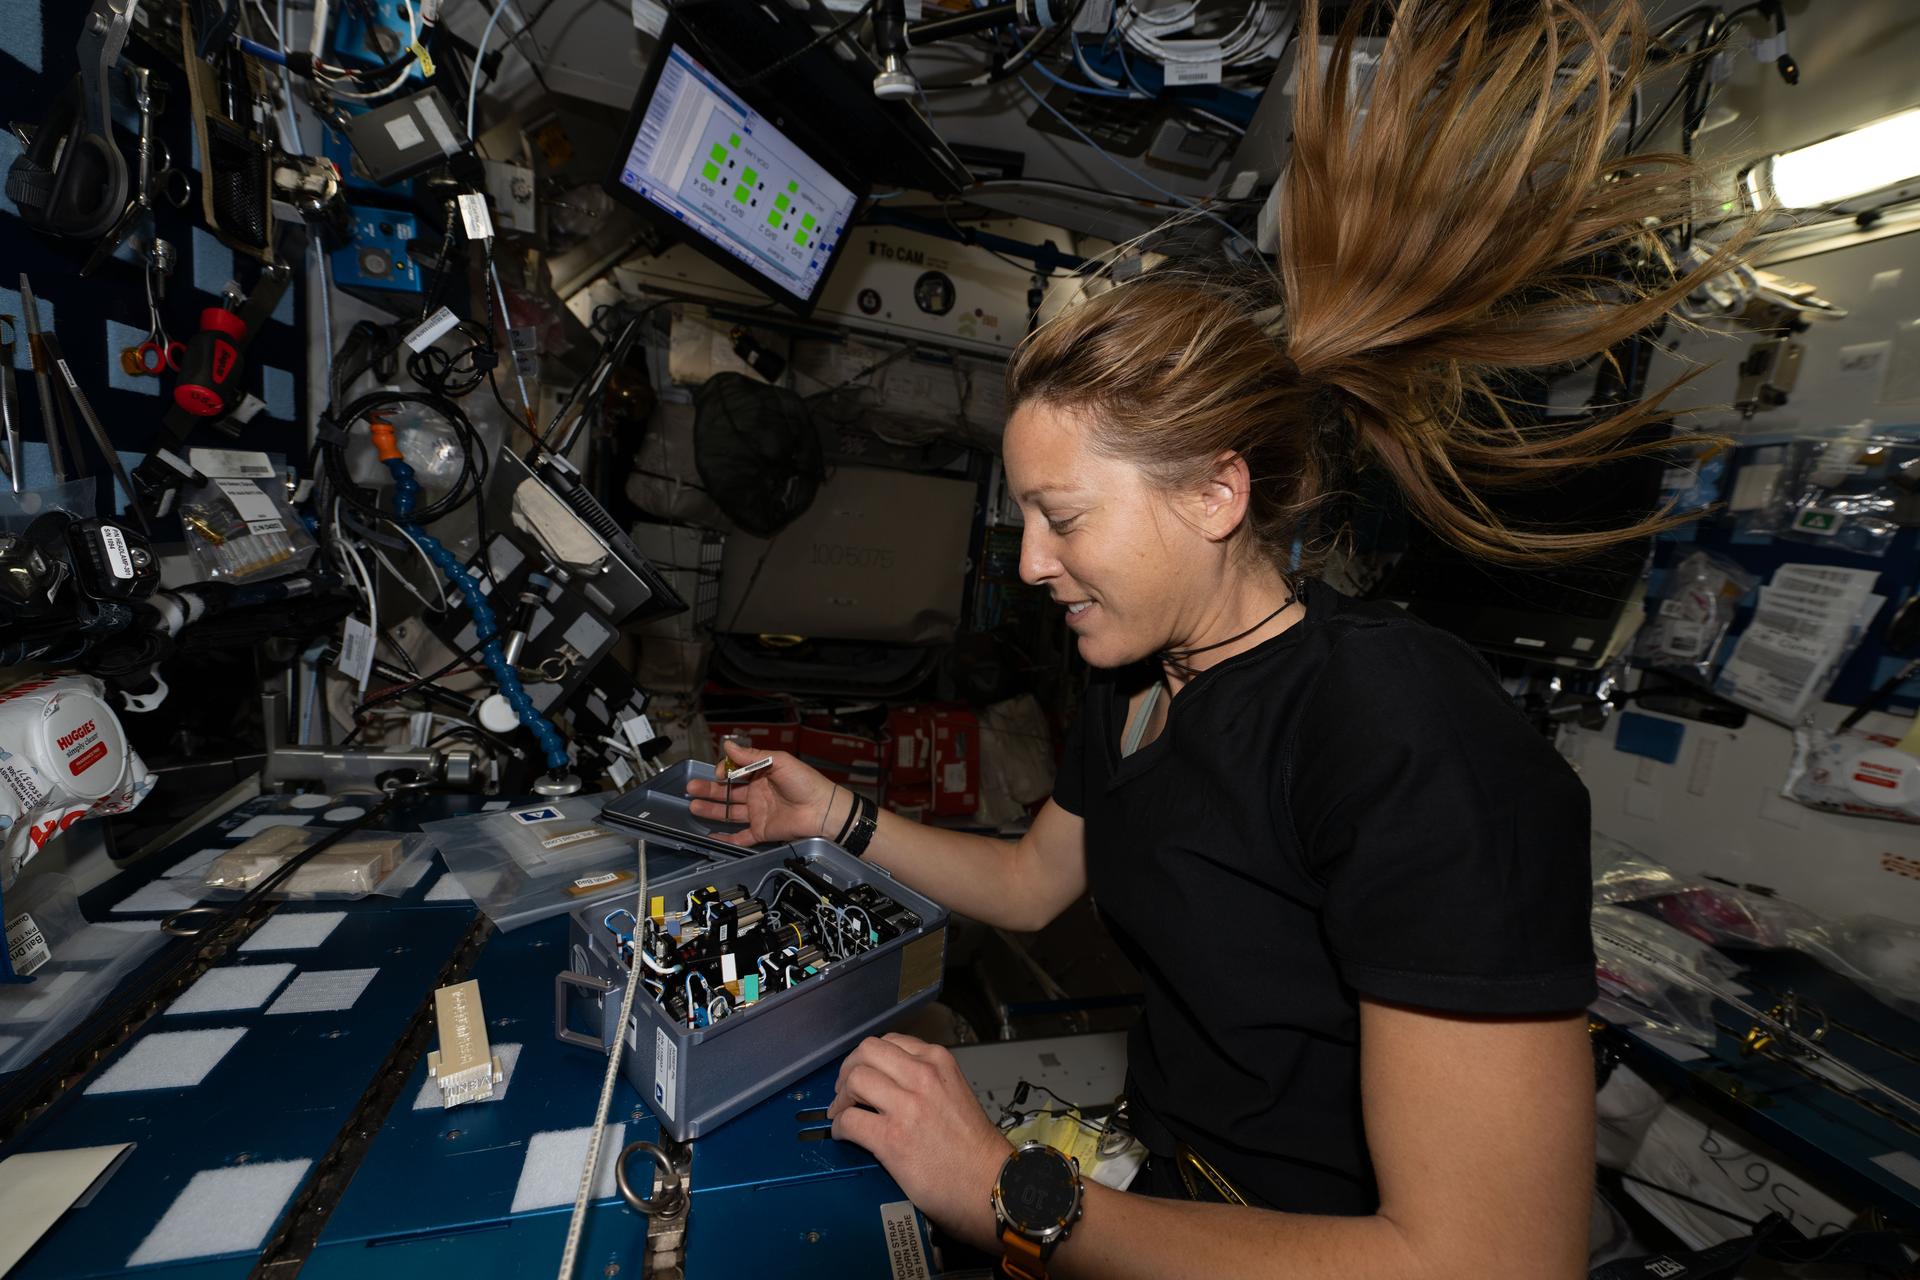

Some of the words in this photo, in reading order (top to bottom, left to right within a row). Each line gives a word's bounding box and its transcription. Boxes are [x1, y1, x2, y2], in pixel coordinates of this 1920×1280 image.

[879, 243, 894, 259] To
[896, 247, 925, 264] CAM
[56, 719, 96, 751] HUGGIES
[66, 741, 85, 758] simply
[10, 783, 25, 801] WIPES
[25, 926, 37, 937] P/N
[25, 934, 44, 951] Ball
[888, 1220, 900, 1248] STRAP
[897, 1221, 908, 1247] WHEN
[904, 1214, 921, 1264] HARDWARE
[902, 1249, 914, 1278] WORN
